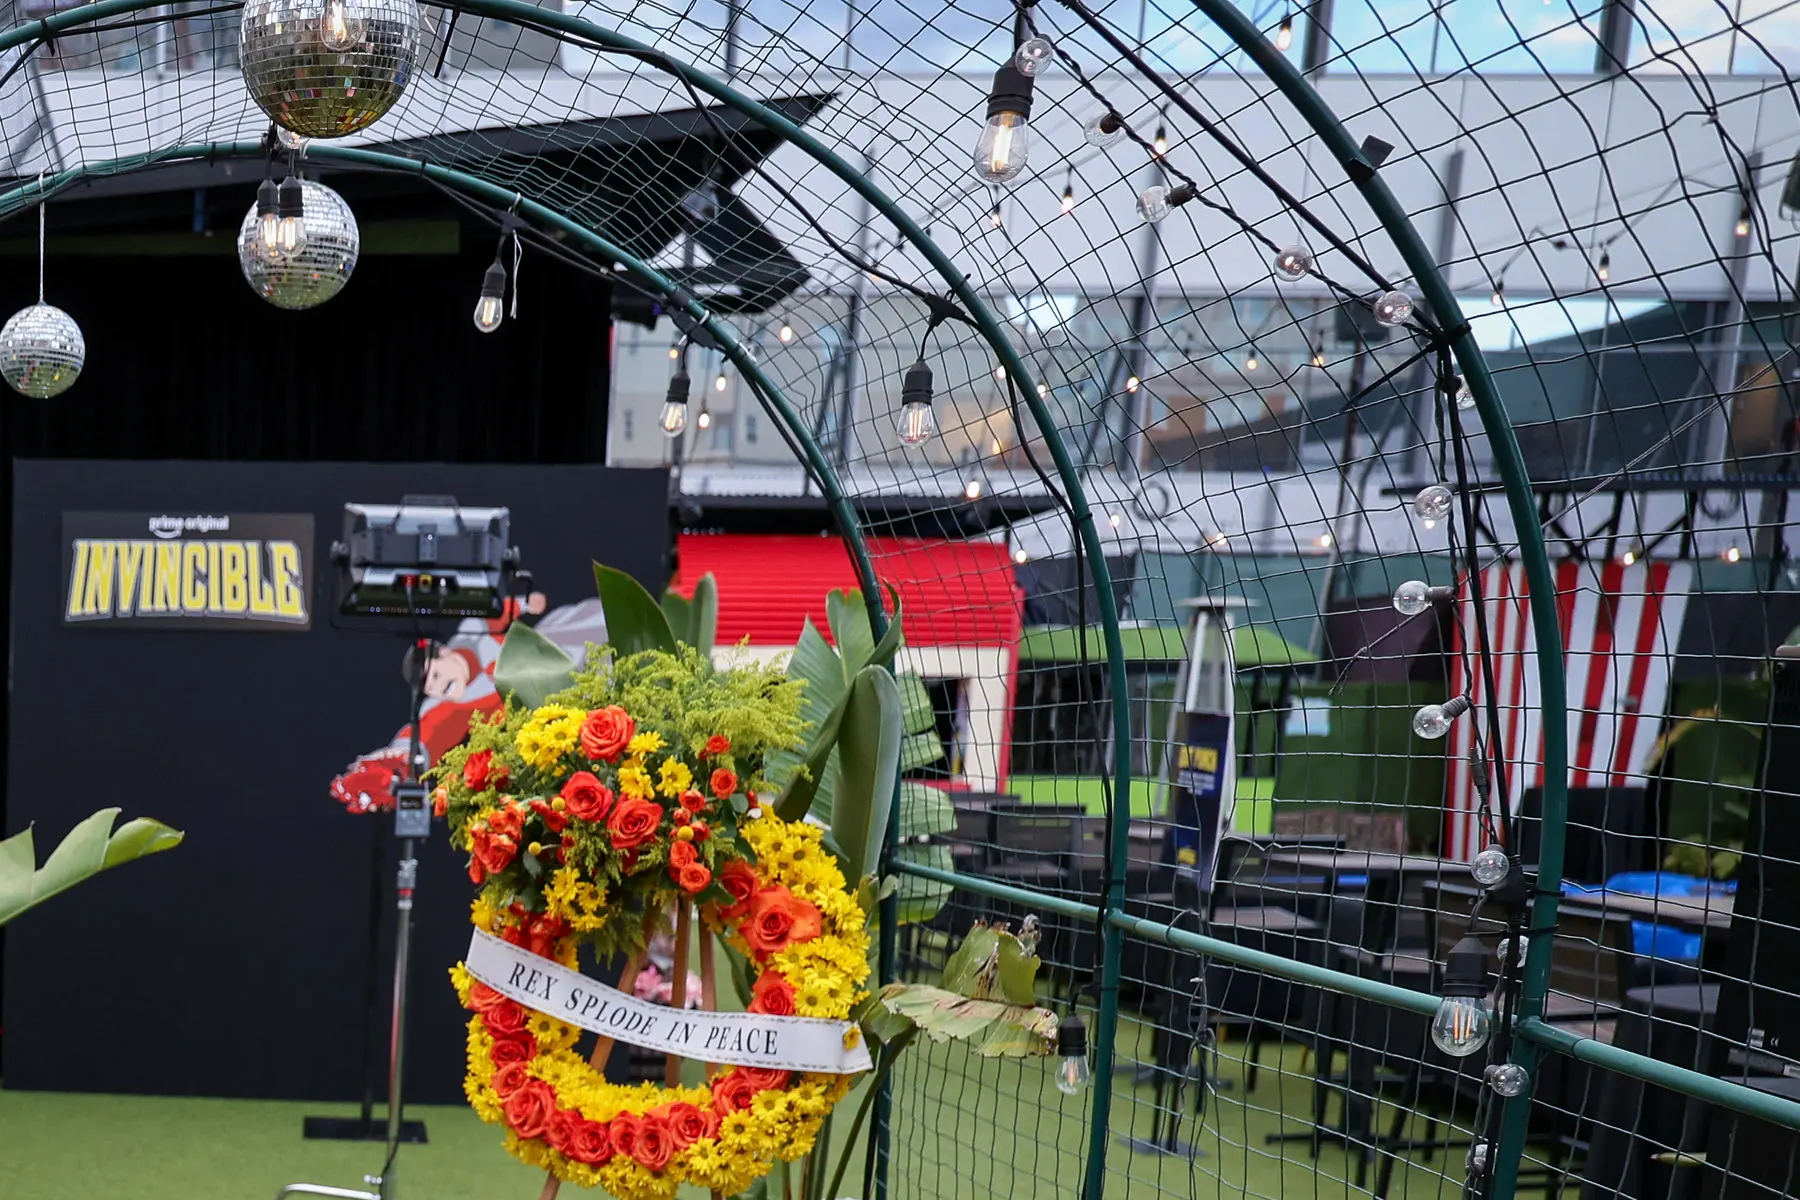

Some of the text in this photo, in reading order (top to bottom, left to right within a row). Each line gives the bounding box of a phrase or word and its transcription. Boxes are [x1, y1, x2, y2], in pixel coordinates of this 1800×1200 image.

[67, 540, 306, 620] INVINCIBLE
[508, 961, 779, 1056] REX SPLODE IN PEACE
